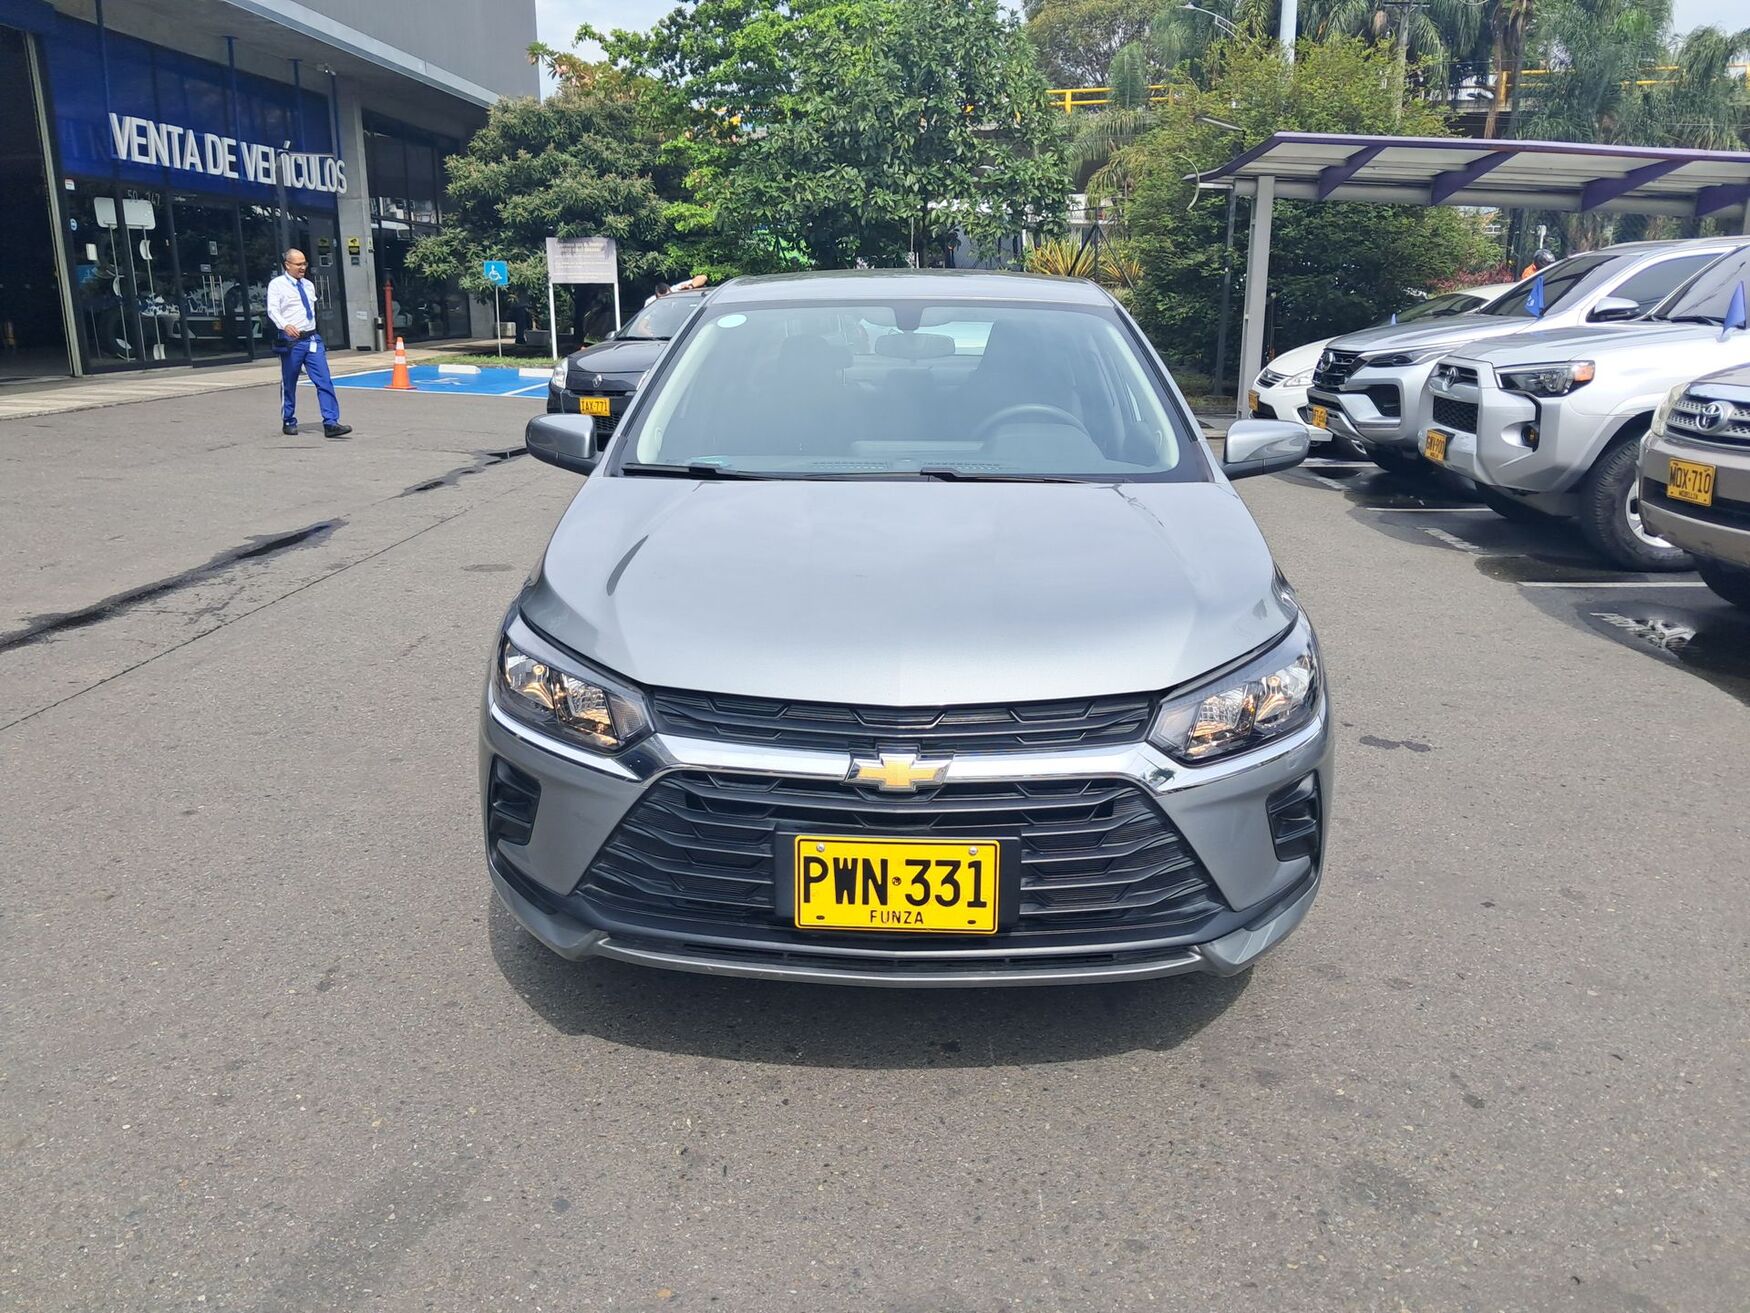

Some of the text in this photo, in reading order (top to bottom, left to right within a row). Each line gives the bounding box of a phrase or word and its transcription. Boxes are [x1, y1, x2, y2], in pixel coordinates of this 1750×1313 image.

[108, 112, 203, 173] VENTA
[204, 133, 240, 179] DE
[870, 909, 924, 925] FUNZA
